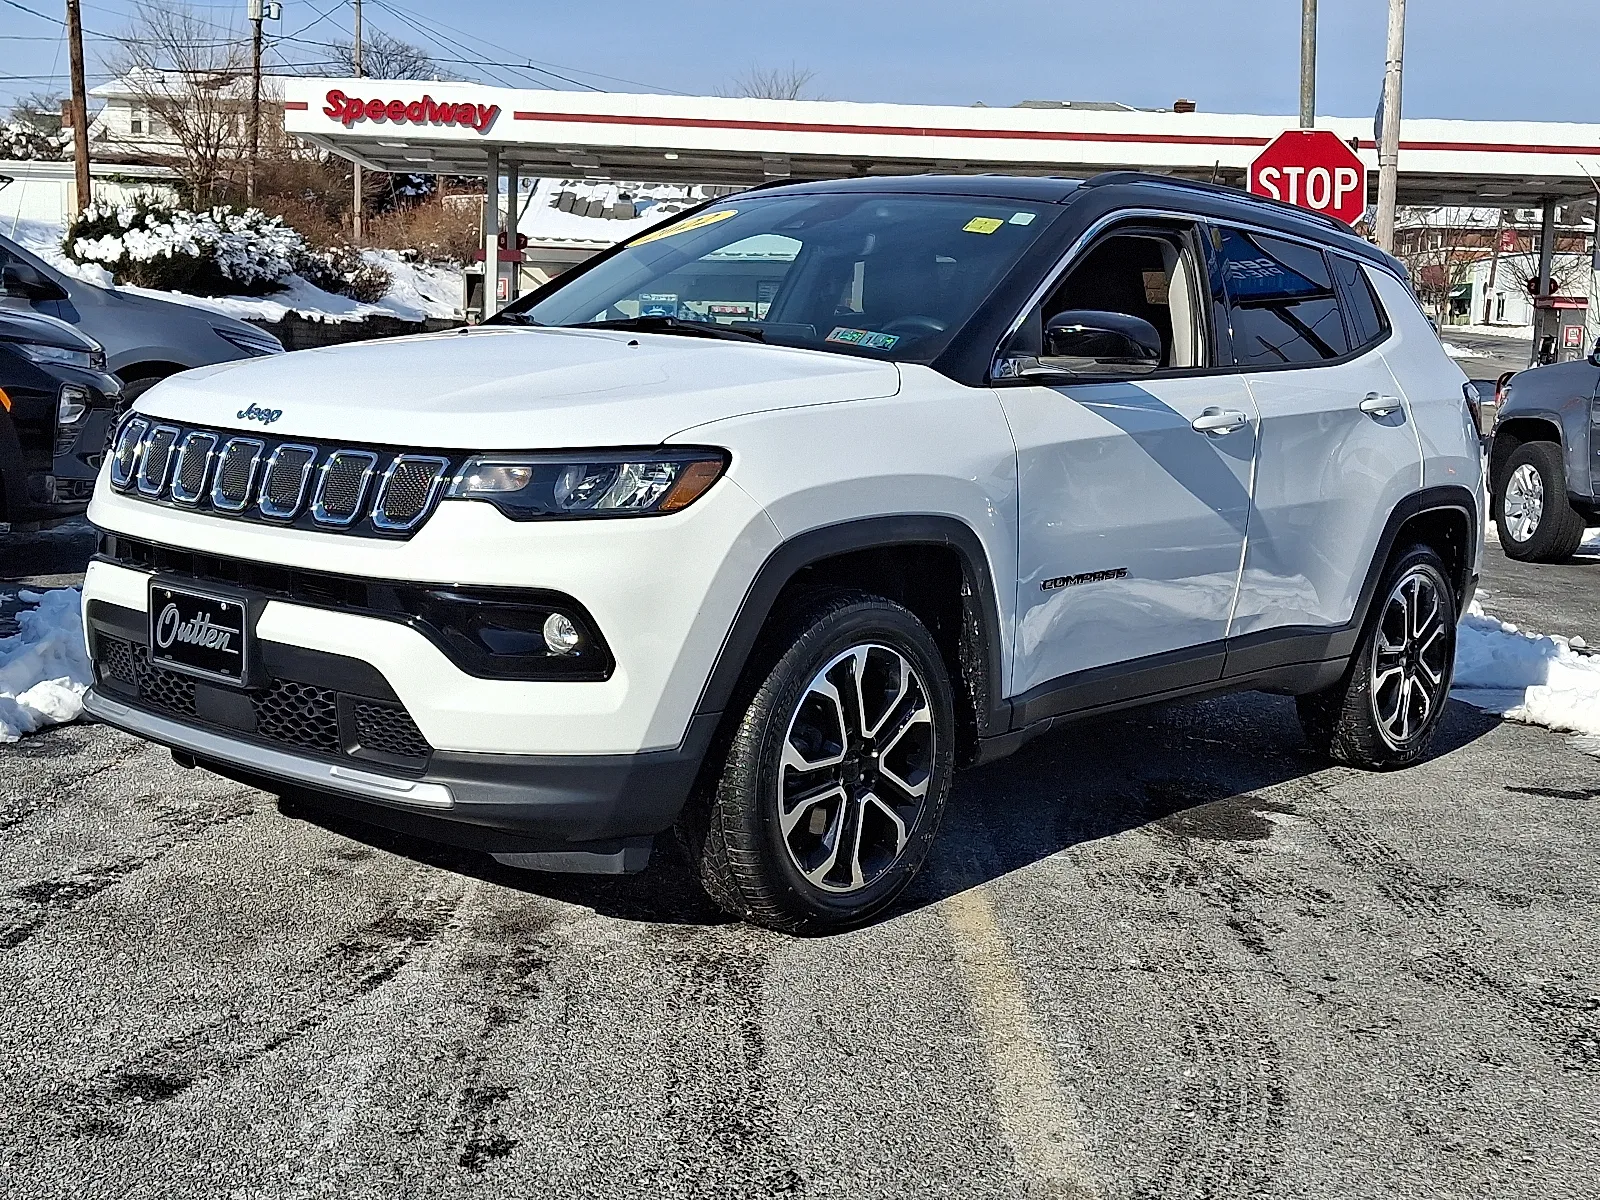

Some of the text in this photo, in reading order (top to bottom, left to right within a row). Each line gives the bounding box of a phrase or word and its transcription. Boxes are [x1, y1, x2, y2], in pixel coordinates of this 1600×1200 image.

[322, 89, 501, 134] Speedway
[1258, 166, 1359, 210] STOP
[236, 402, 283, 425] Jeep
[156, 602, 240, 654] Outten
